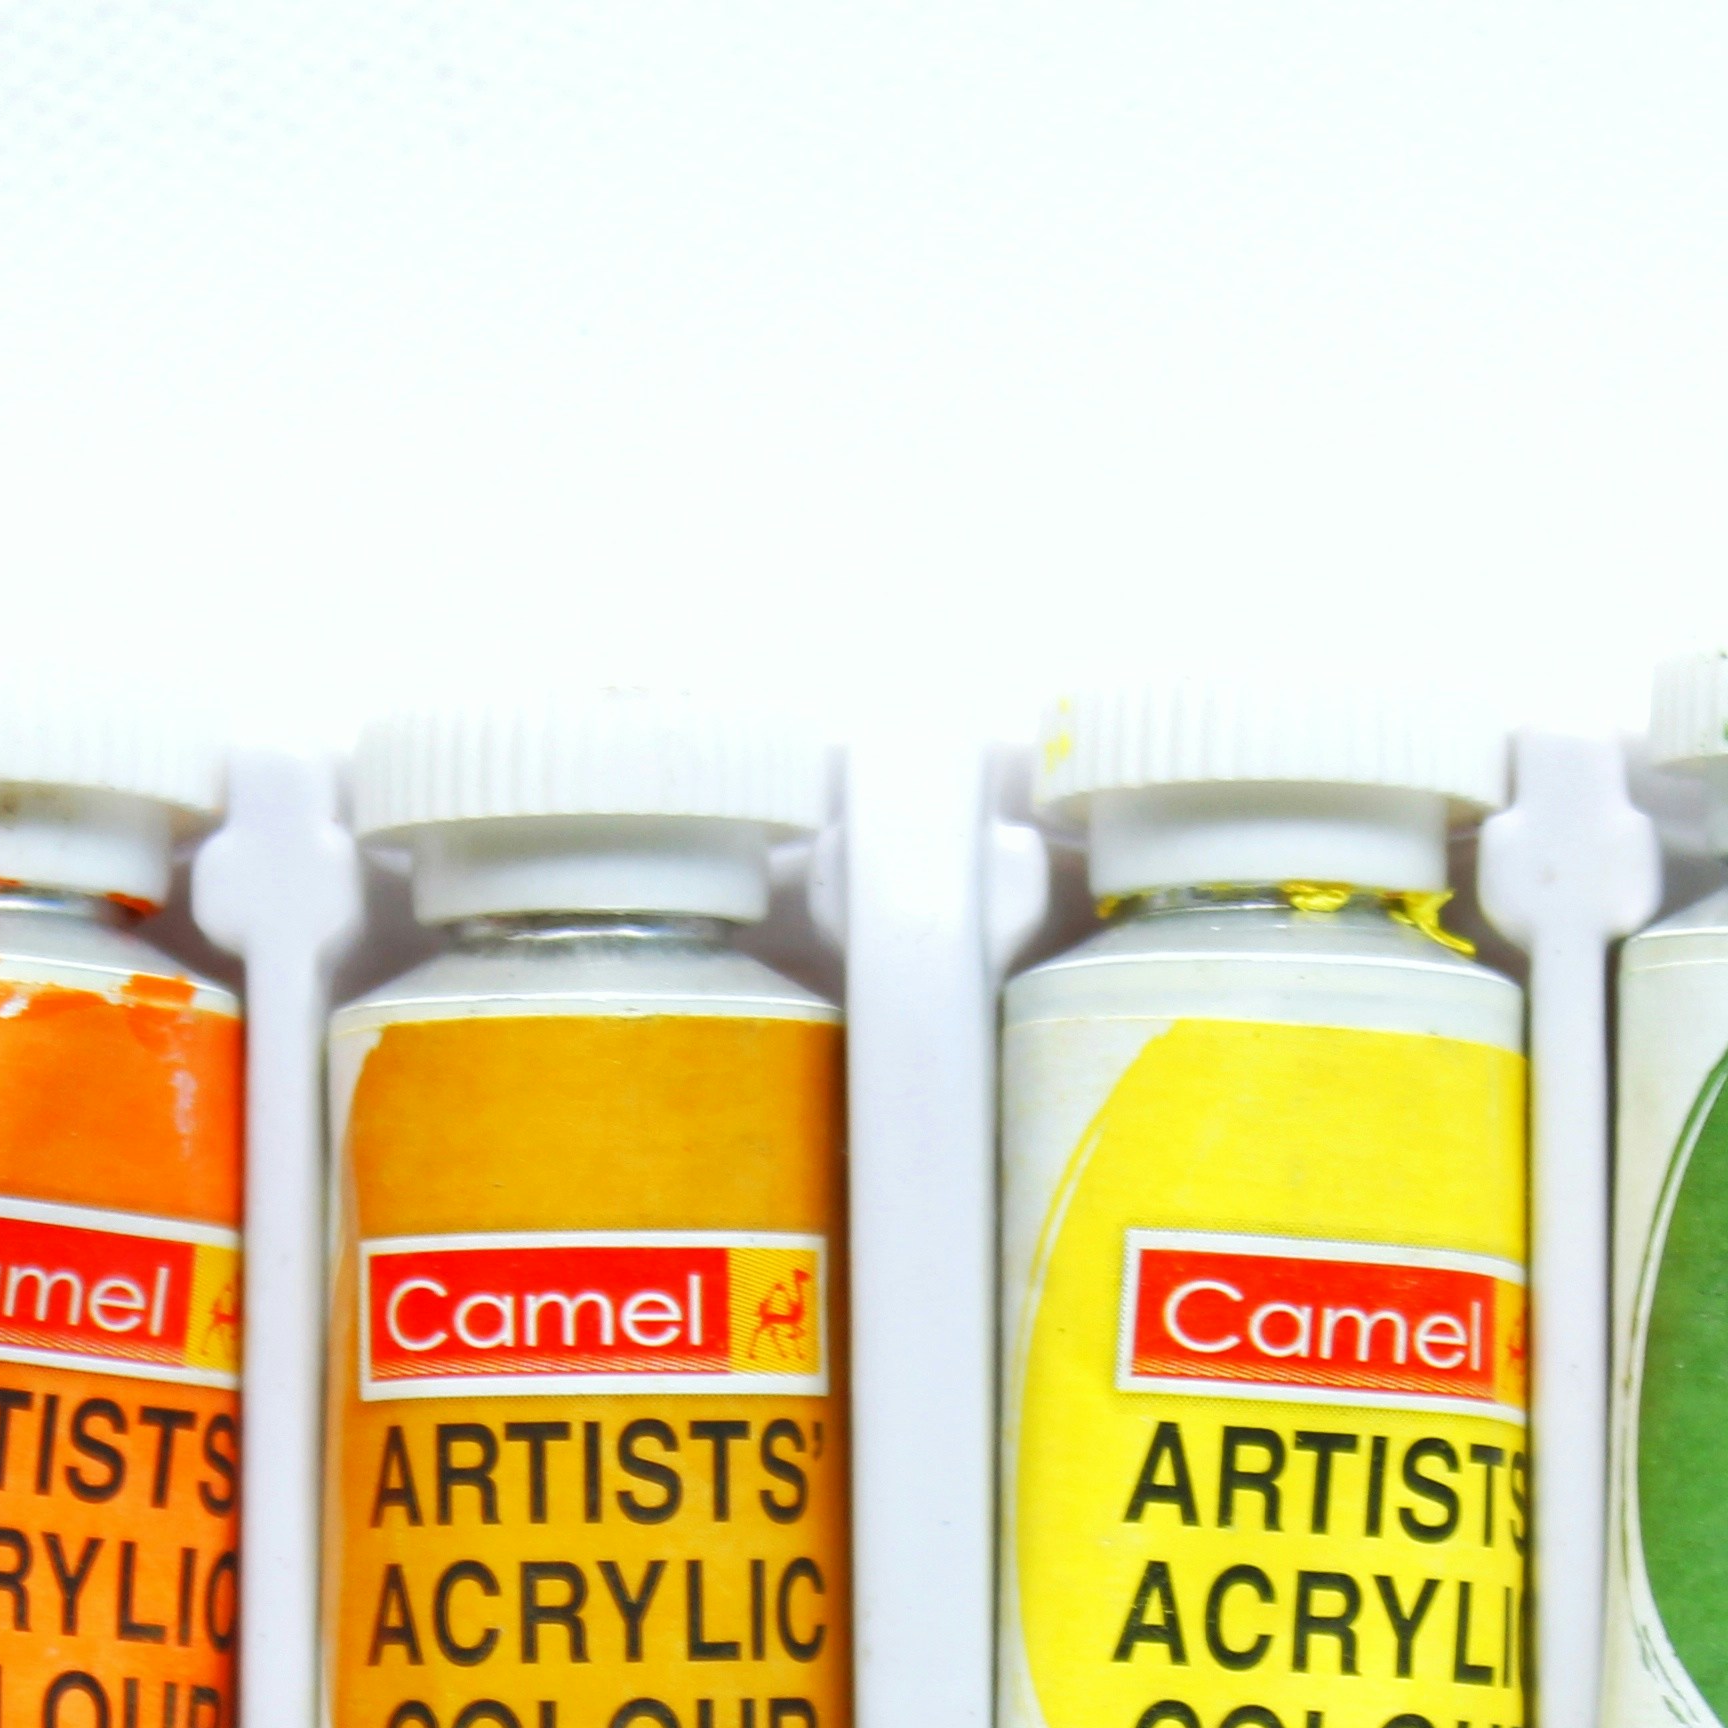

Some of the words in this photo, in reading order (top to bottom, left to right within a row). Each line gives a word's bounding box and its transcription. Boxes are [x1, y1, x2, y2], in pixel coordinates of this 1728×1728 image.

[386, 1273, 703, 1352] Camel
[1163, 1278, 1483, 1372] Camel
[370, 1418, 824, 1529] ARTISTS'
[367, 1556, 826, 1669] ACRYLIC
[1111, 1560, 1526, 1691] ACRYLI
